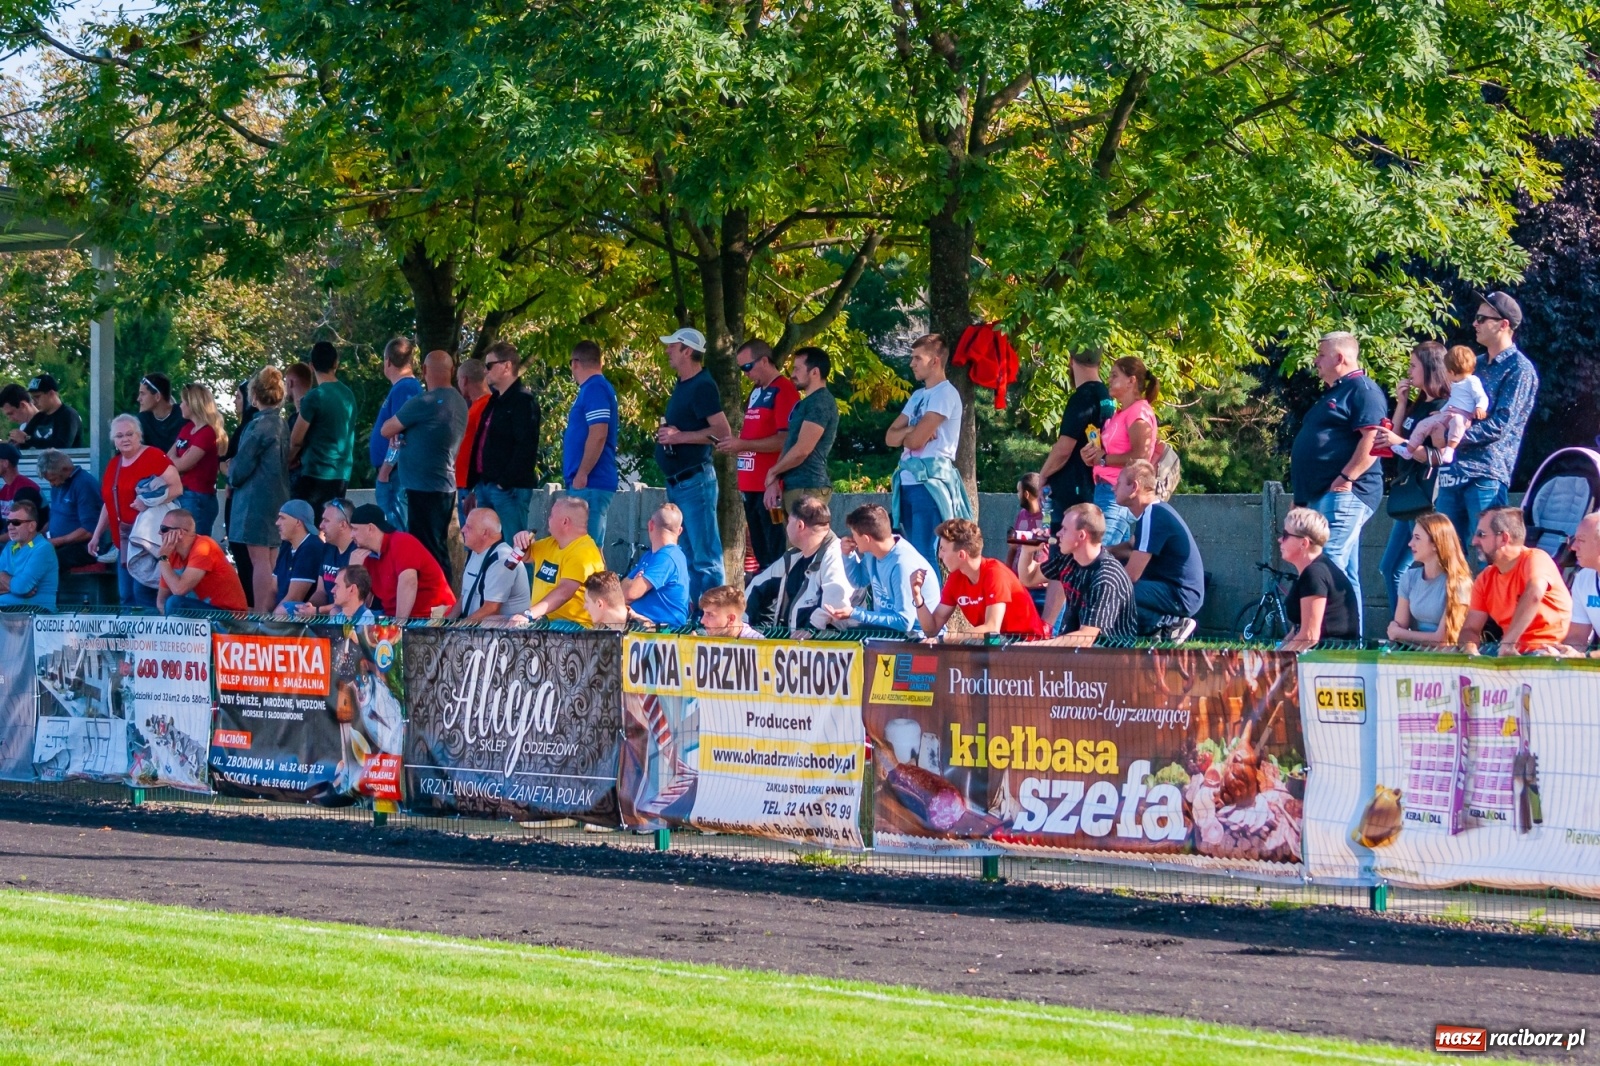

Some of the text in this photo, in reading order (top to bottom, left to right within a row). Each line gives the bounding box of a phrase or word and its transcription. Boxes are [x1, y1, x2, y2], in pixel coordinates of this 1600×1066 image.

[35, 619, 65, 633] OSIEDLE
[108, 617, 156, 635] TWORKÓW
[156, 622, 208, 637] HANOWIEC
[117, 640, 158, 653] ZABUDOWIE
[160, 642, 208, 655] SZEREGOWEJ
[217, 641, 325, 675] KREWETKA
[137, 658, 158, 679] 600
[161, 659, 182, 680] 980
[184, 661, 208, 681] 516
[629, 641, 680, 687] OKNA
[697, 645, 758, 691] DRZWI
[774, 649, 853, 696] SCHODY
[219, 674, 241, 685] SKLEP
[242, 675, 270, 687] RYBNY
[283, 676, 325, 690] SMAŻALNIA
[948, 667, 1107, 709] Producent kiełbasy
[135, 691, 152, 701] działki
[154, 692, 162, 701] od
[181, 694, 190, 703] do
[1317, 691, 1333, 707] C2
[1414, 682, 1442, 701] H40
[1482, 689, 1508, 707] H40
[220, 693, 327, 711] RYBY ŚWIEŻE, MROŻONE, WĘDZONE
[443, 638, 561, 778] Alicja
[242, 709, 264, 719] MORSKIE
[746, 711, 812, 730] Producent
[1050, 701, 1191, 731] surowo-dojrzewającej
[479, 739, 579, 757] SKLEP ODZIEŻOWY
[949, 722, 1119, 775] kiełbasa
[213, 755, 275, 771] UL. ZBOROWA 5A
[713, 749, 855, 773] www.oknadrzwischody.pl
[224, 771, 252, 786] OCICKA
[420, 778, 594, 806] KRZYŻANOWICE, ŻANETA POLAK
[766, 782, 855, 797] ZAKŁAD STOLARSKI PAWLIK
[1012, 759, 1187, 841] szefa
[762, 800, 851, 820] TEL. 32 419 62 99
[1405, 811, 1442, 824] KERAKOLL
[1469, 809, 1506, 821] KERAKOLL
[775, 823, 839, 840] Bojanowska
[842, 827, 854, 841] 41
